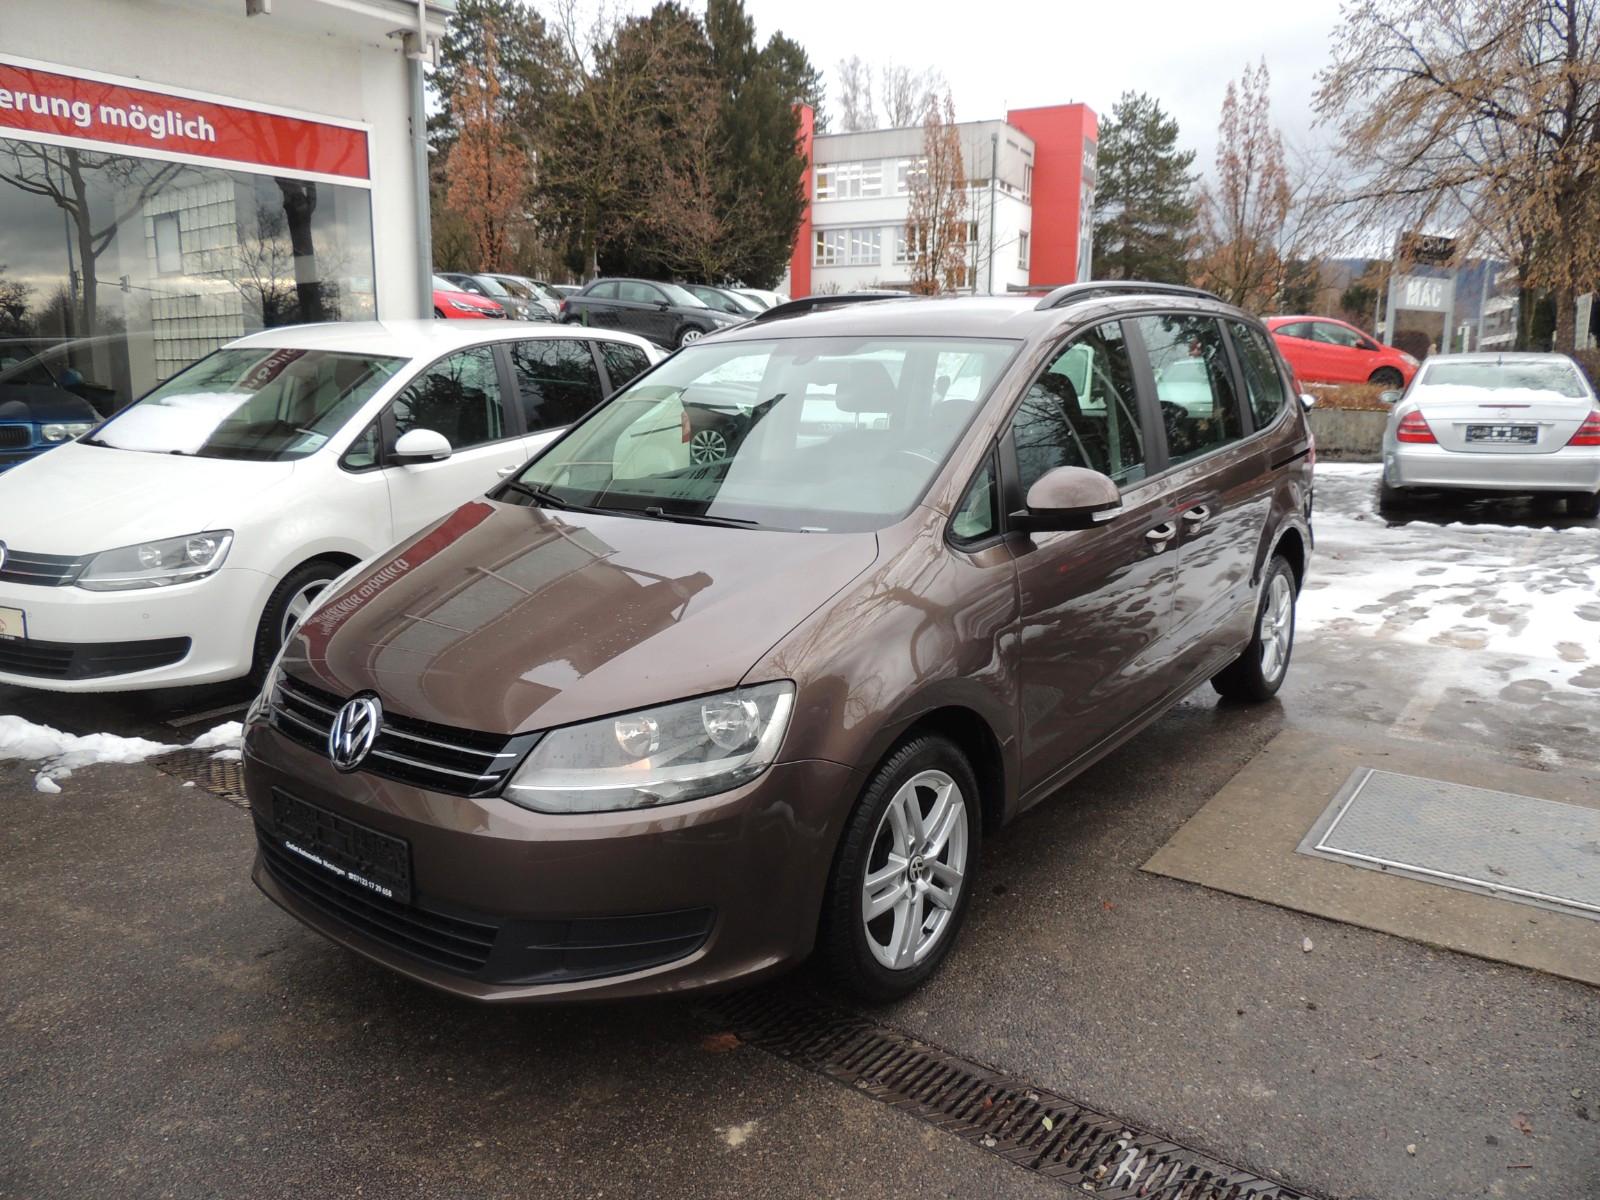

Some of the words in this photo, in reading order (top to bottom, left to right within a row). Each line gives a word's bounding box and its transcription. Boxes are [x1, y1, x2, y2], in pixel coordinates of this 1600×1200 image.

[0, 88, 91, 126] erung
[100, 105, 215, 142] möglich
[1406, 281, 1442, 307] MAC
